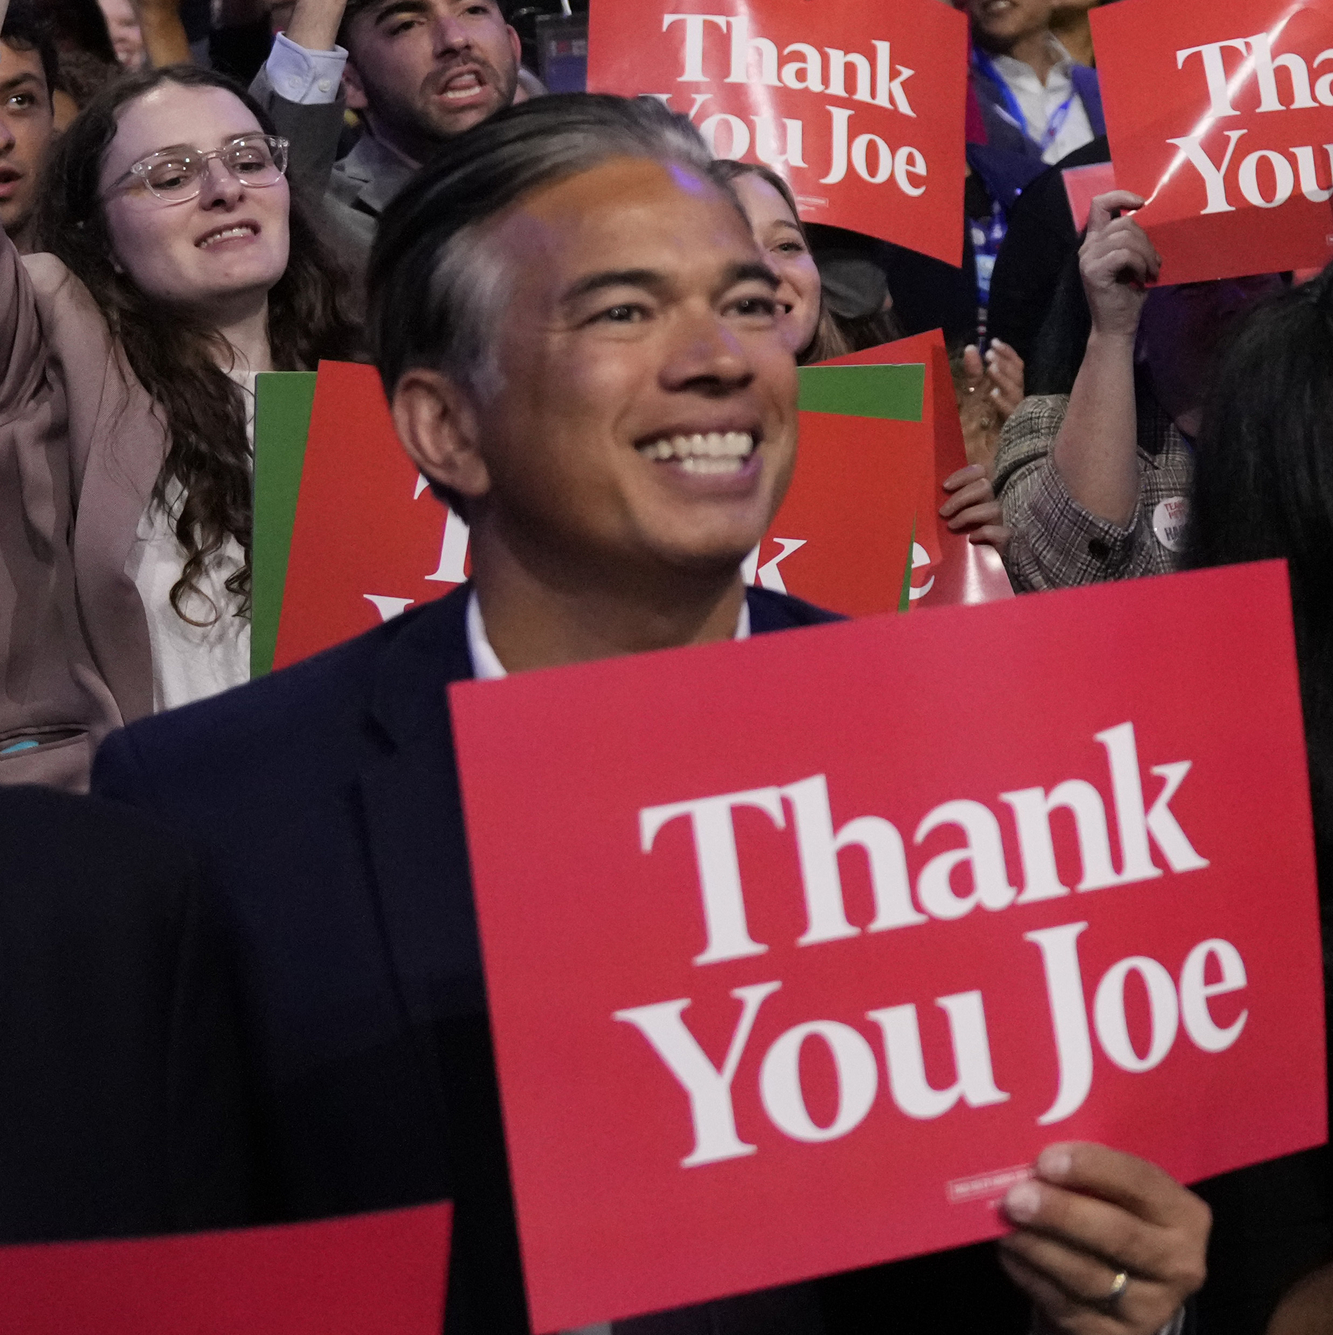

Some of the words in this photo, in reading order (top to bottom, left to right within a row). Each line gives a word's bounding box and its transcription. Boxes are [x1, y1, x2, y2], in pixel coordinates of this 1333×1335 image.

[662, 13, 917, 118] Thank
[819, 105, 928, 198] Joe
[637, 720, 1211, 967] Thank
[612, 980, 1011, 1169] You
[1024, 920, 1250, 1125] Joe
